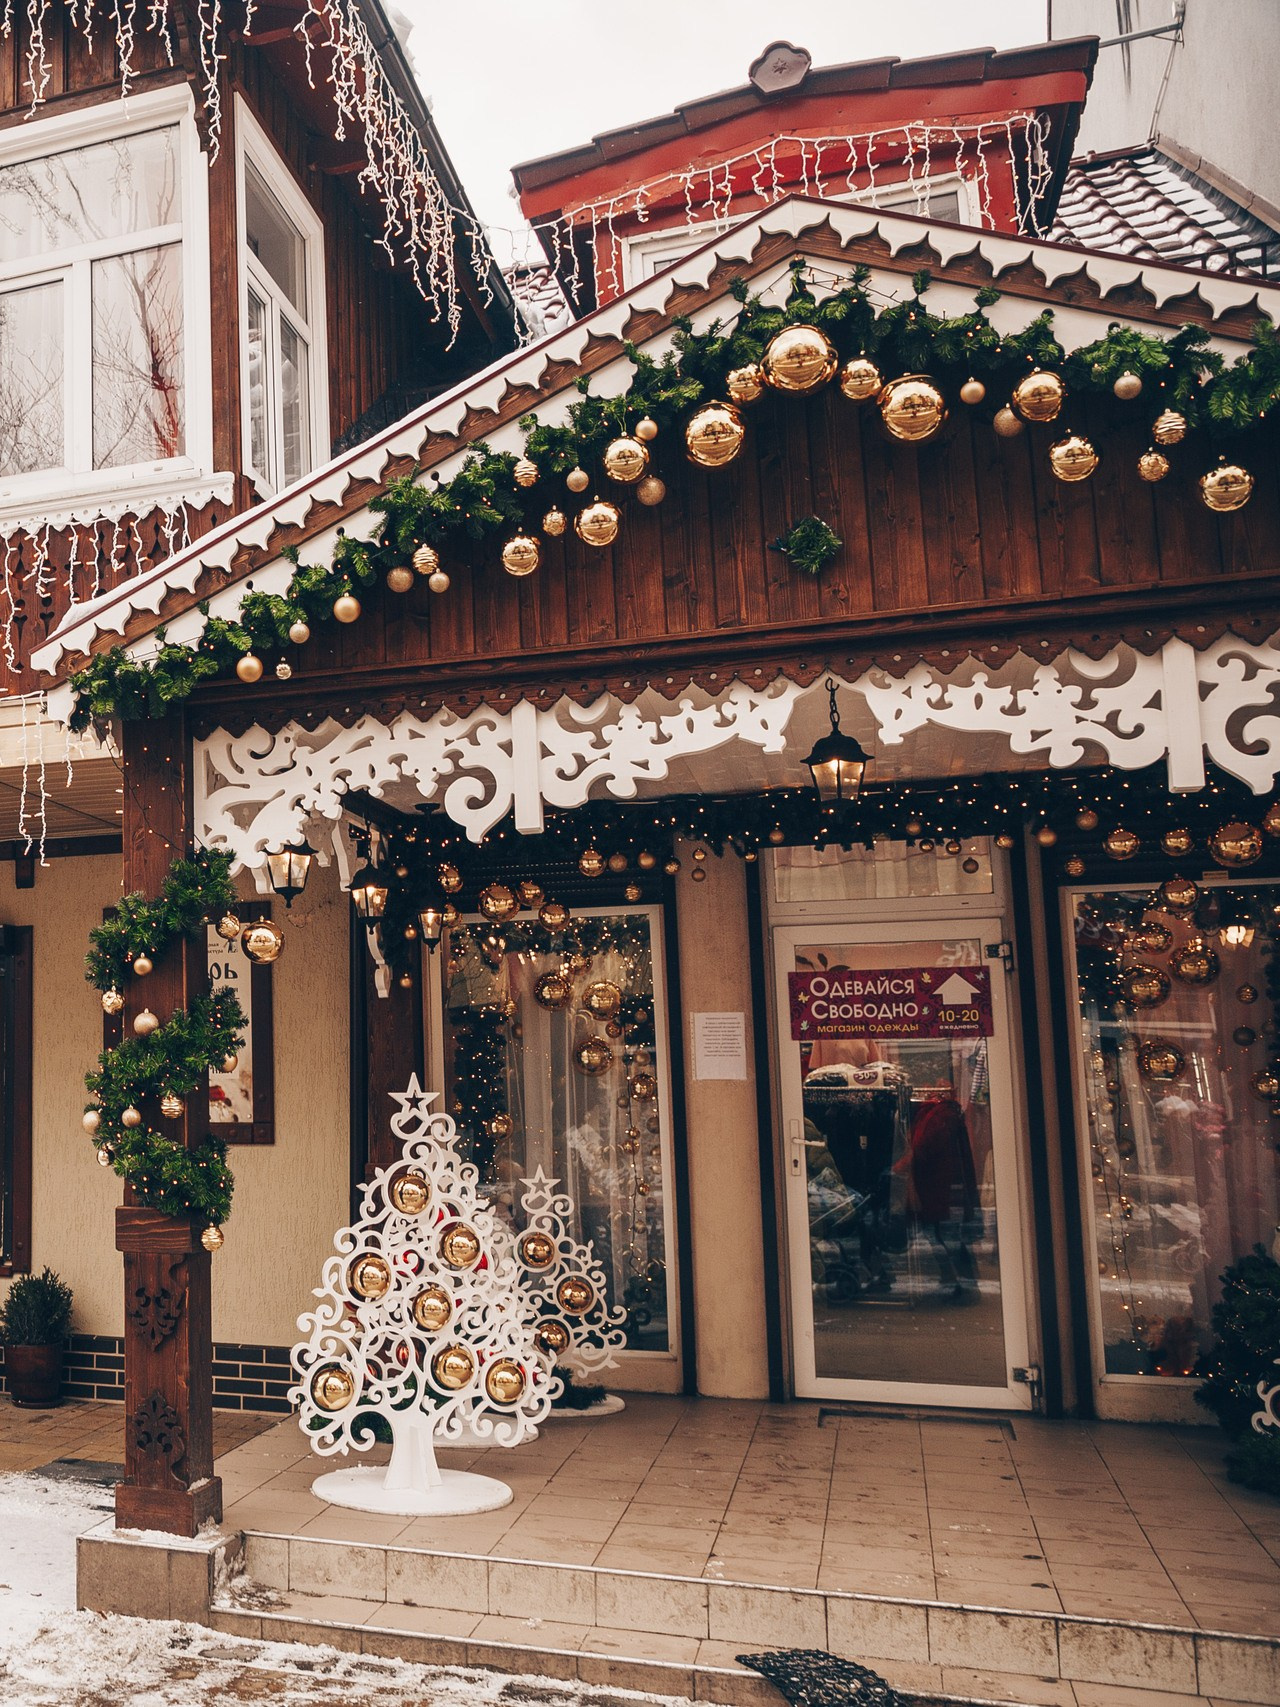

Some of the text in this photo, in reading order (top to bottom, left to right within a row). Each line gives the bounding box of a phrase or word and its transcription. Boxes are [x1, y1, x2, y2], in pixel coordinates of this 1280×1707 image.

[937, 1009, 980, 1022] 10-20
[817, 1023, 919, 1033] магазин одежды
